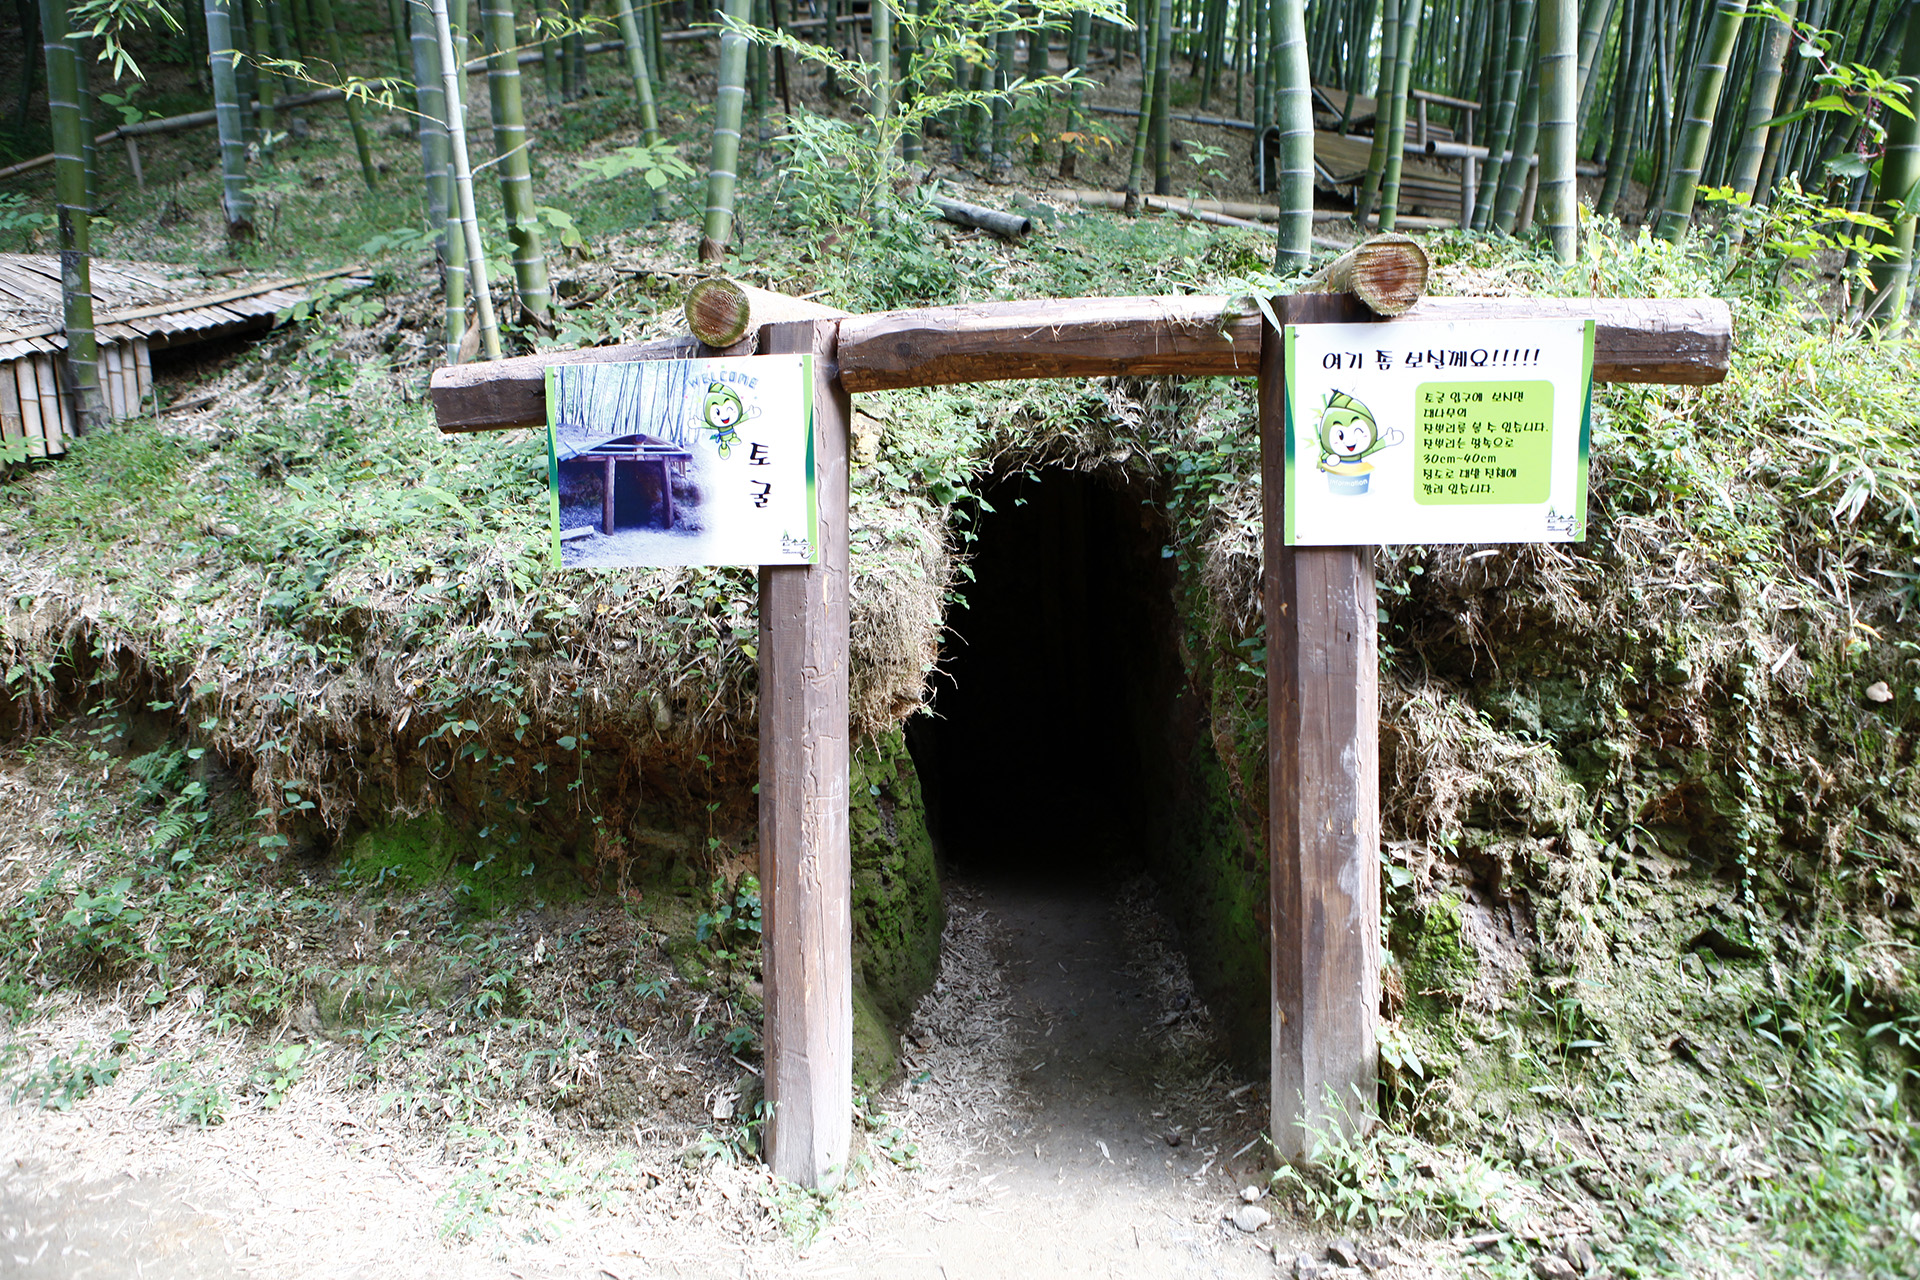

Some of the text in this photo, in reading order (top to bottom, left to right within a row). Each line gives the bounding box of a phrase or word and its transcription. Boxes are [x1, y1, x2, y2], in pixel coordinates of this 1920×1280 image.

[1322, 348, 1541, 370] 여기 좀 보실께요!!!!!
[687, 371, 759, 389] WELCOME
[1424, 391, 1525, 404] 토굴 입구에 보시면
[1423, 407, 1467, 418] 대나무의
[1423, 421, 1466, 435] 잔뿌리를
[1487, 421, 1498, 433] 수
[1500, 420, 1549, 434] 있습니다.
[1423, 436, 1515, 449] 잔뿌리는 땅속으로
[1423, 453, 1497, 464] 30cm~40cm
[748, 442, 772, 508] 토굴
[1423, 467, 1454, 480] 정도로
[1484, 466, 1517, 479] 전체에
[1422, 482, 1495, 495] 깔려 있습니다.
